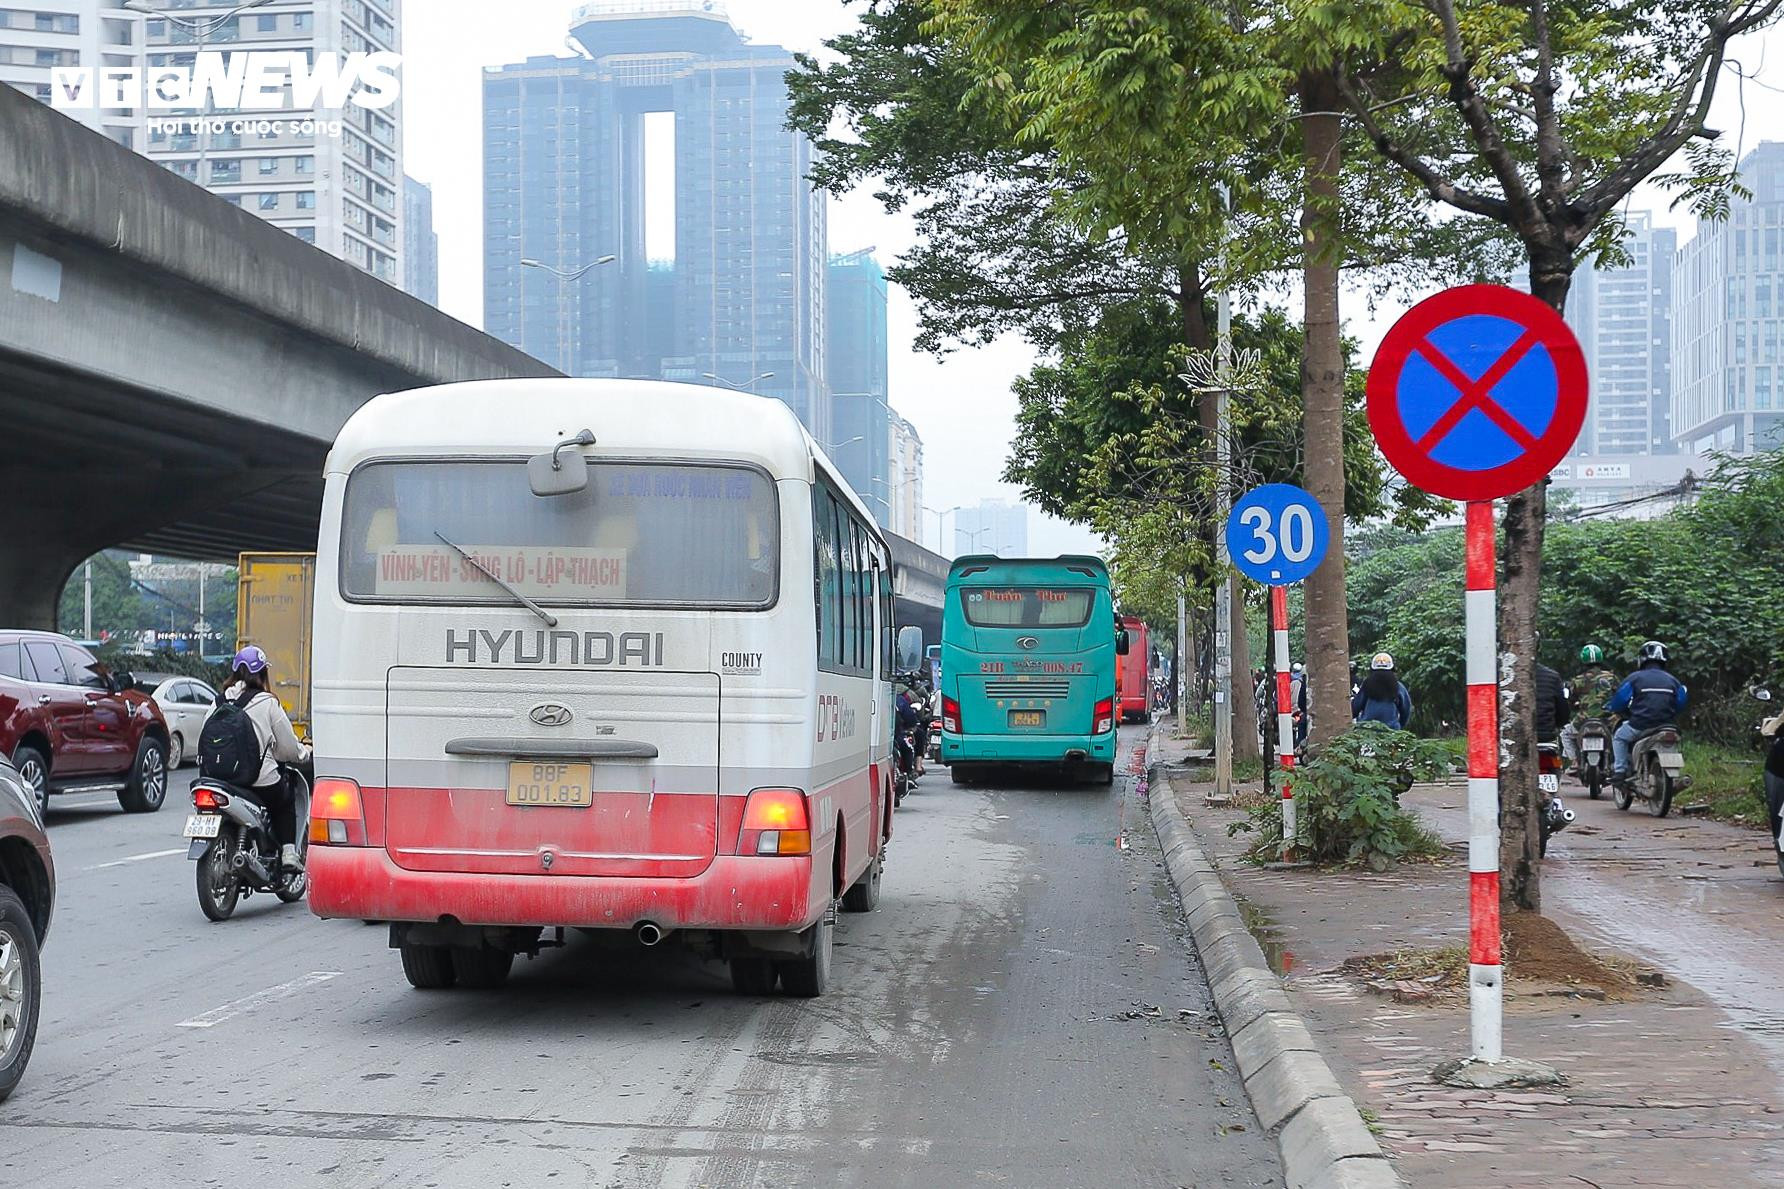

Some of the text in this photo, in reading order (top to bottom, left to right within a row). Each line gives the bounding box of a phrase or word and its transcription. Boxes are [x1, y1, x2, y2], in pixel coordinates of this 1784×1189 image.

[1240, 504, 1314, 564] 30
[382, 549, 417, 582] VĨNH
[421, 549, 450, 582] YÊN
[460, 550, 501, 583] SÔNG
[507, 551, 525, 584] LÔ
[537, 551, 564, 589] LẬP
[570, 557, 620, 589] THẠCH
[446, 629, 664, 666] HYUNDAI
[722, 652, 763, 668] COUNTY
[533, 765, 568, 782] 88F
[517, 784, 582, 802] 001.83
